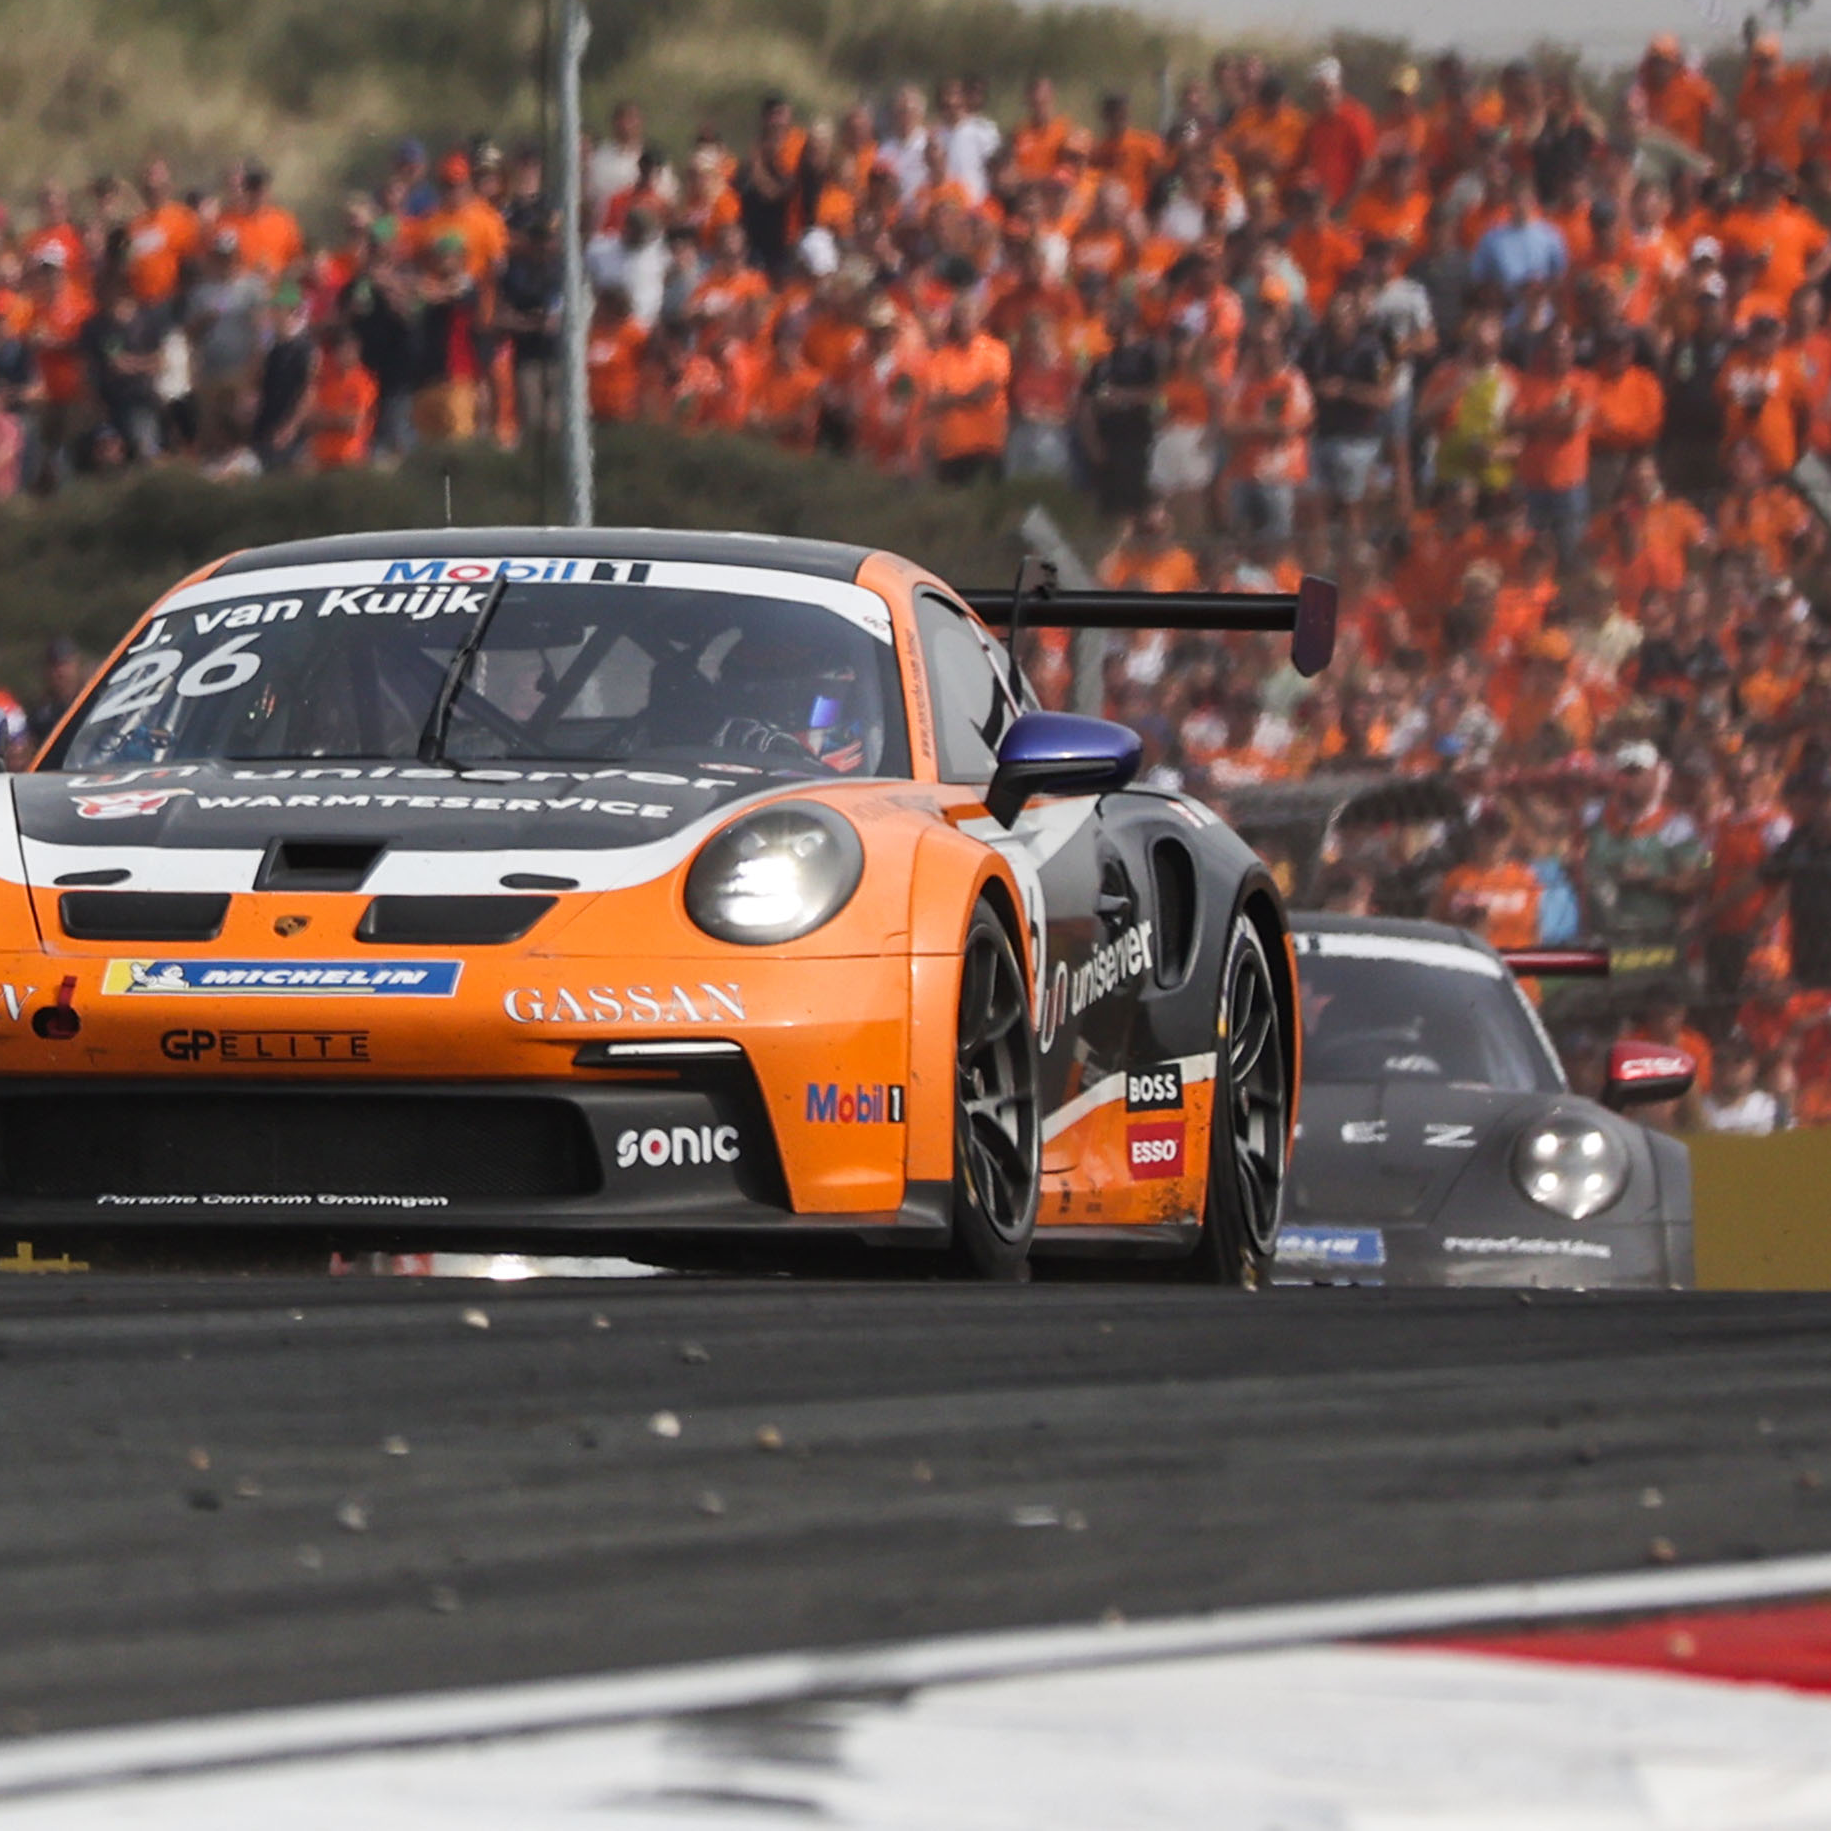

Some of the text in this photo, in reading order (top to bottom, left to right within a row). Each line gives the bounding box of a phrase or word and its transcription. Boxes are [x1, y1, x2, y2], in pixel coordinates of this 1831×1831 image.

[383, 558, 579, 584] Mobil
[128, 582, 489, 655] J. van Kuijk
[89, 633, 263, 725] 26
[196, 794, 674, 819] WARMTESERVICE
[202, 968, 429, 986] MICHELIN
[1071, 919, 1153, 1017] uniserver
[502, 982, 749, 1024] GASSAN
[1128, 1074, 1178, 1102] BOSS
[804, 1082, 884, 1124] Mobil
[1131, 1138, 1177, 1164] ESSO
[96, 1193, 449, 1208] Porsche Centrum Groningen
